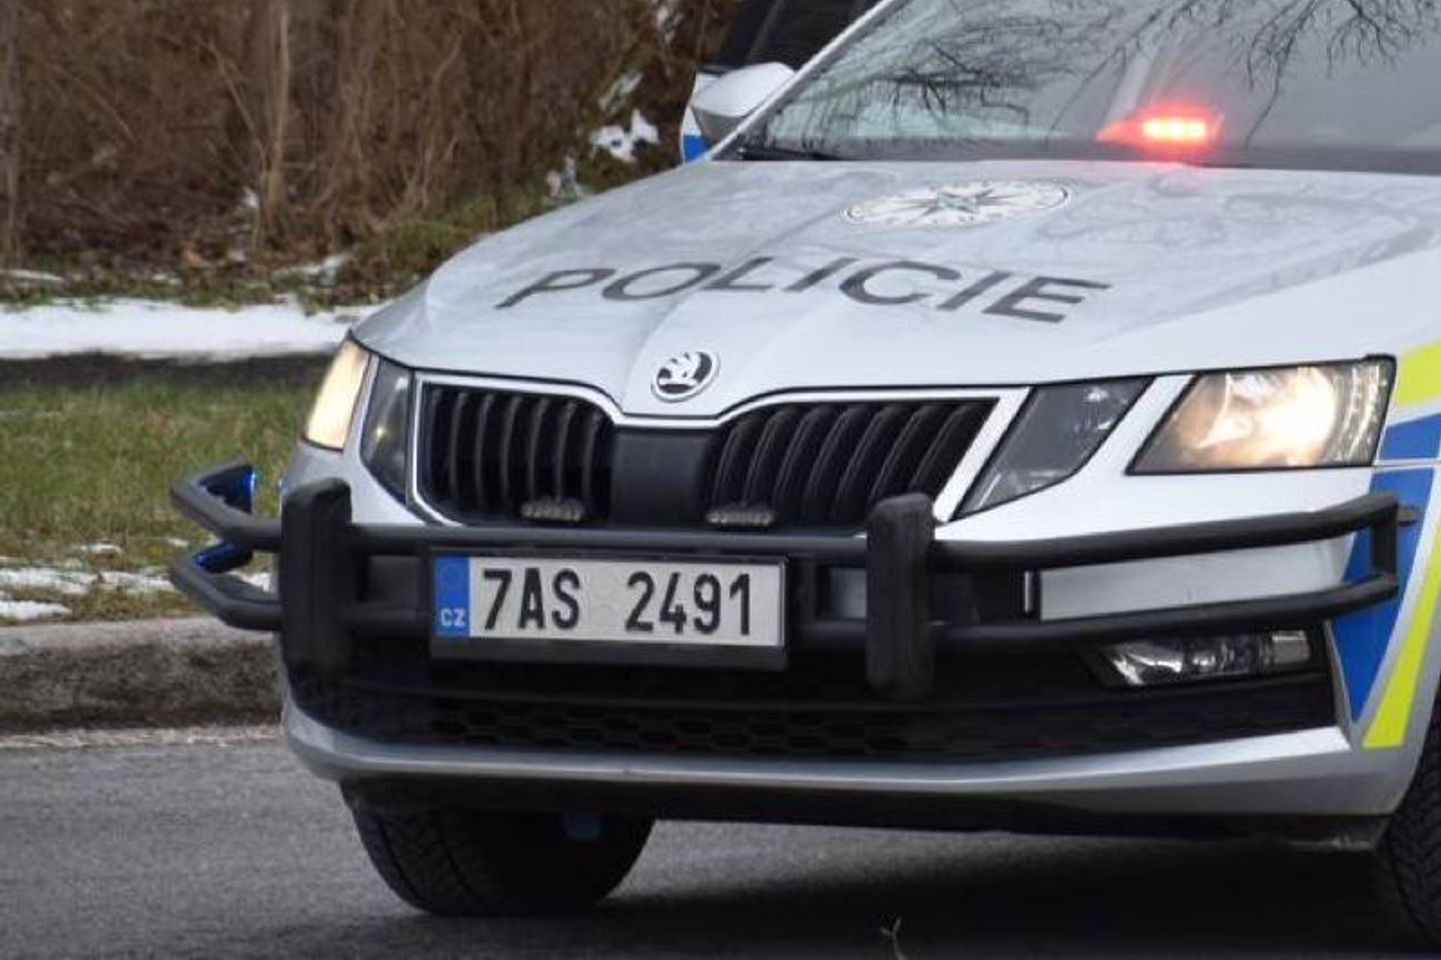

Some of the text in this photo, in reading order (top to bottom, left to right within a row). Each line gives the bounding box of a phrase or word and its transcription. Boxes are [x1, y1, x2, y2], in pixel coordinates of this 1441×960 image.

[495, 255, 1111, 324] POLICIE
[440, 607, 467, 628] CZ
[482, 567, 751, 635] 7AS 2491
